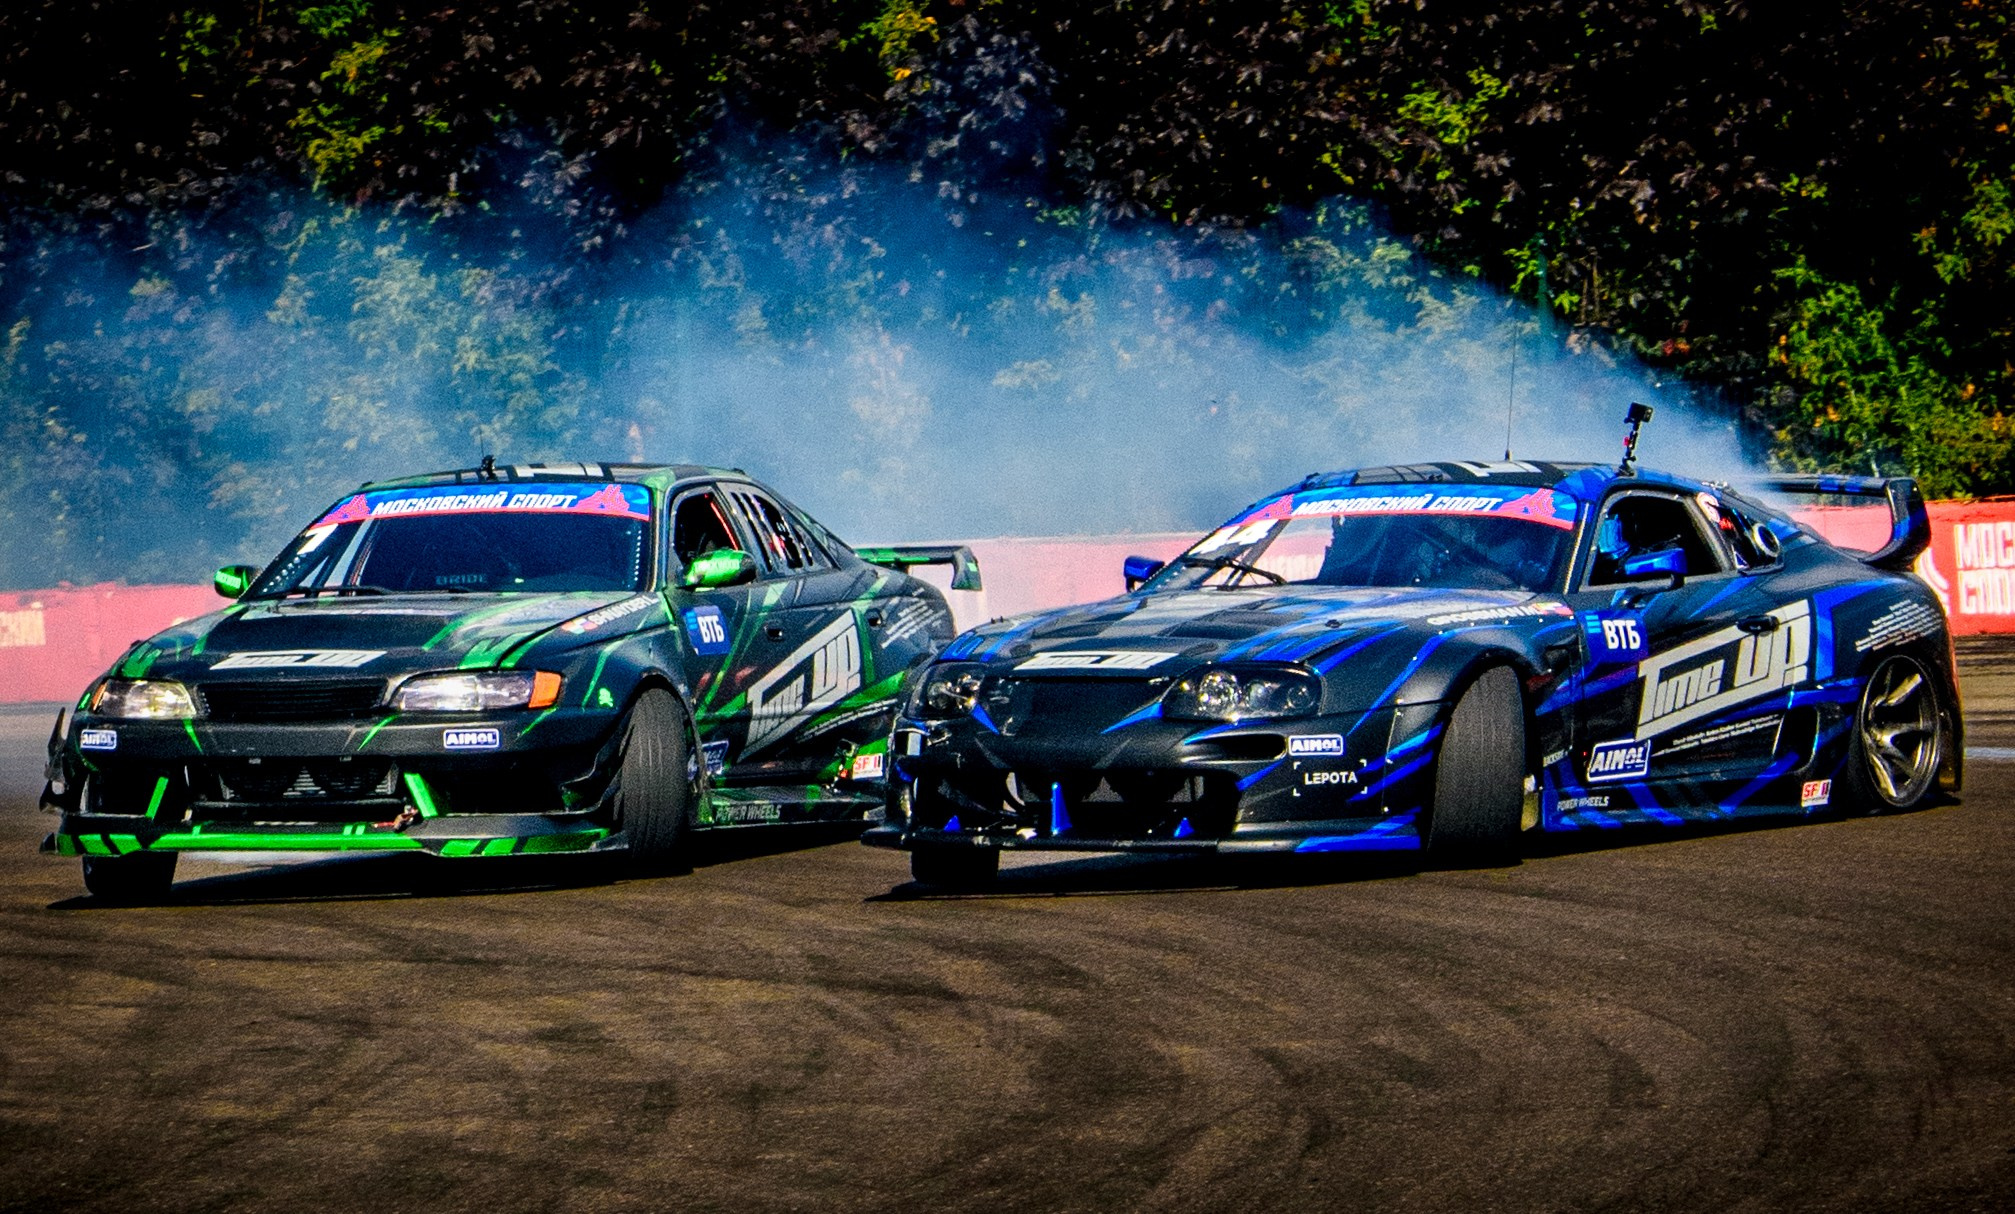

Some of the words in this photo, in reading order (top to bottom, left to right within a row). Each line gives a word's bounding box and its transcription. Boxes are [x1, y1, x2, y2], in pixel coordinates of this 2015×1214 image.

[372, 491, 509, 516] МОСКОВСКИЙ
[508, 493, 578, 509] СПОРТ
[1292, 493, 1434, 517] МОСКОВСКИЙ
[1427, 496, 1504, 512] СПОРТ
[1954, 521, 2015, 569] МОС
[1958, 568, 2015, 615] СПО
[697, 615, 725, 644] ВТБ
[1601, 619, 1641, 650] ВТБ
[446, 732, 496, 745] AIMOL
[1291, 739, 1340, 752] AIMOL
[1590, 746, 1646, 773] AIMOL
[1304, 771, 1358, 785] LEPOTA
[747, 804, 782, 820] WHEELS
[1578, 796, 1610, 808] WHEELS
